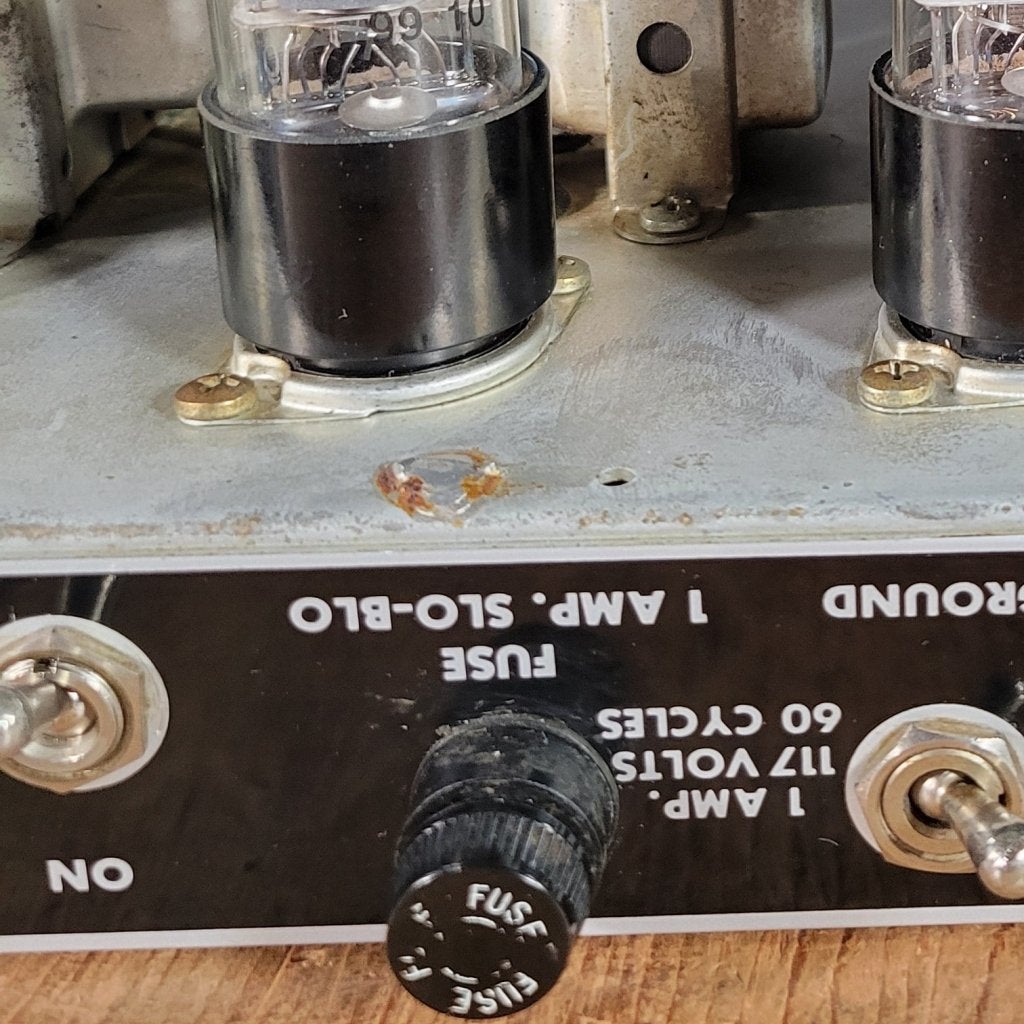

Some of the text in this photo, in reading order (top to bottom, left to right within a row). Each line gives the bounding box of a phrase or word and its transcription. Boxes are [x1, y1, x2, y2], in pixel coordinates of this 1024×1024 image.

[369, 5, 422, 41] 99
[287, 589, 709, 634] 1 AMP. SLO-BLO
[438, 643, 558, 682] FUSE
[597, 702, 843, 740] 60 CYCLES
[611, 745, 837, 783] 117 VOLTS
[647, 786, 806, 820] 1 AMP.
[45, 857, 135, 894] ON
[448, 971, 540, 1016] FUSE
